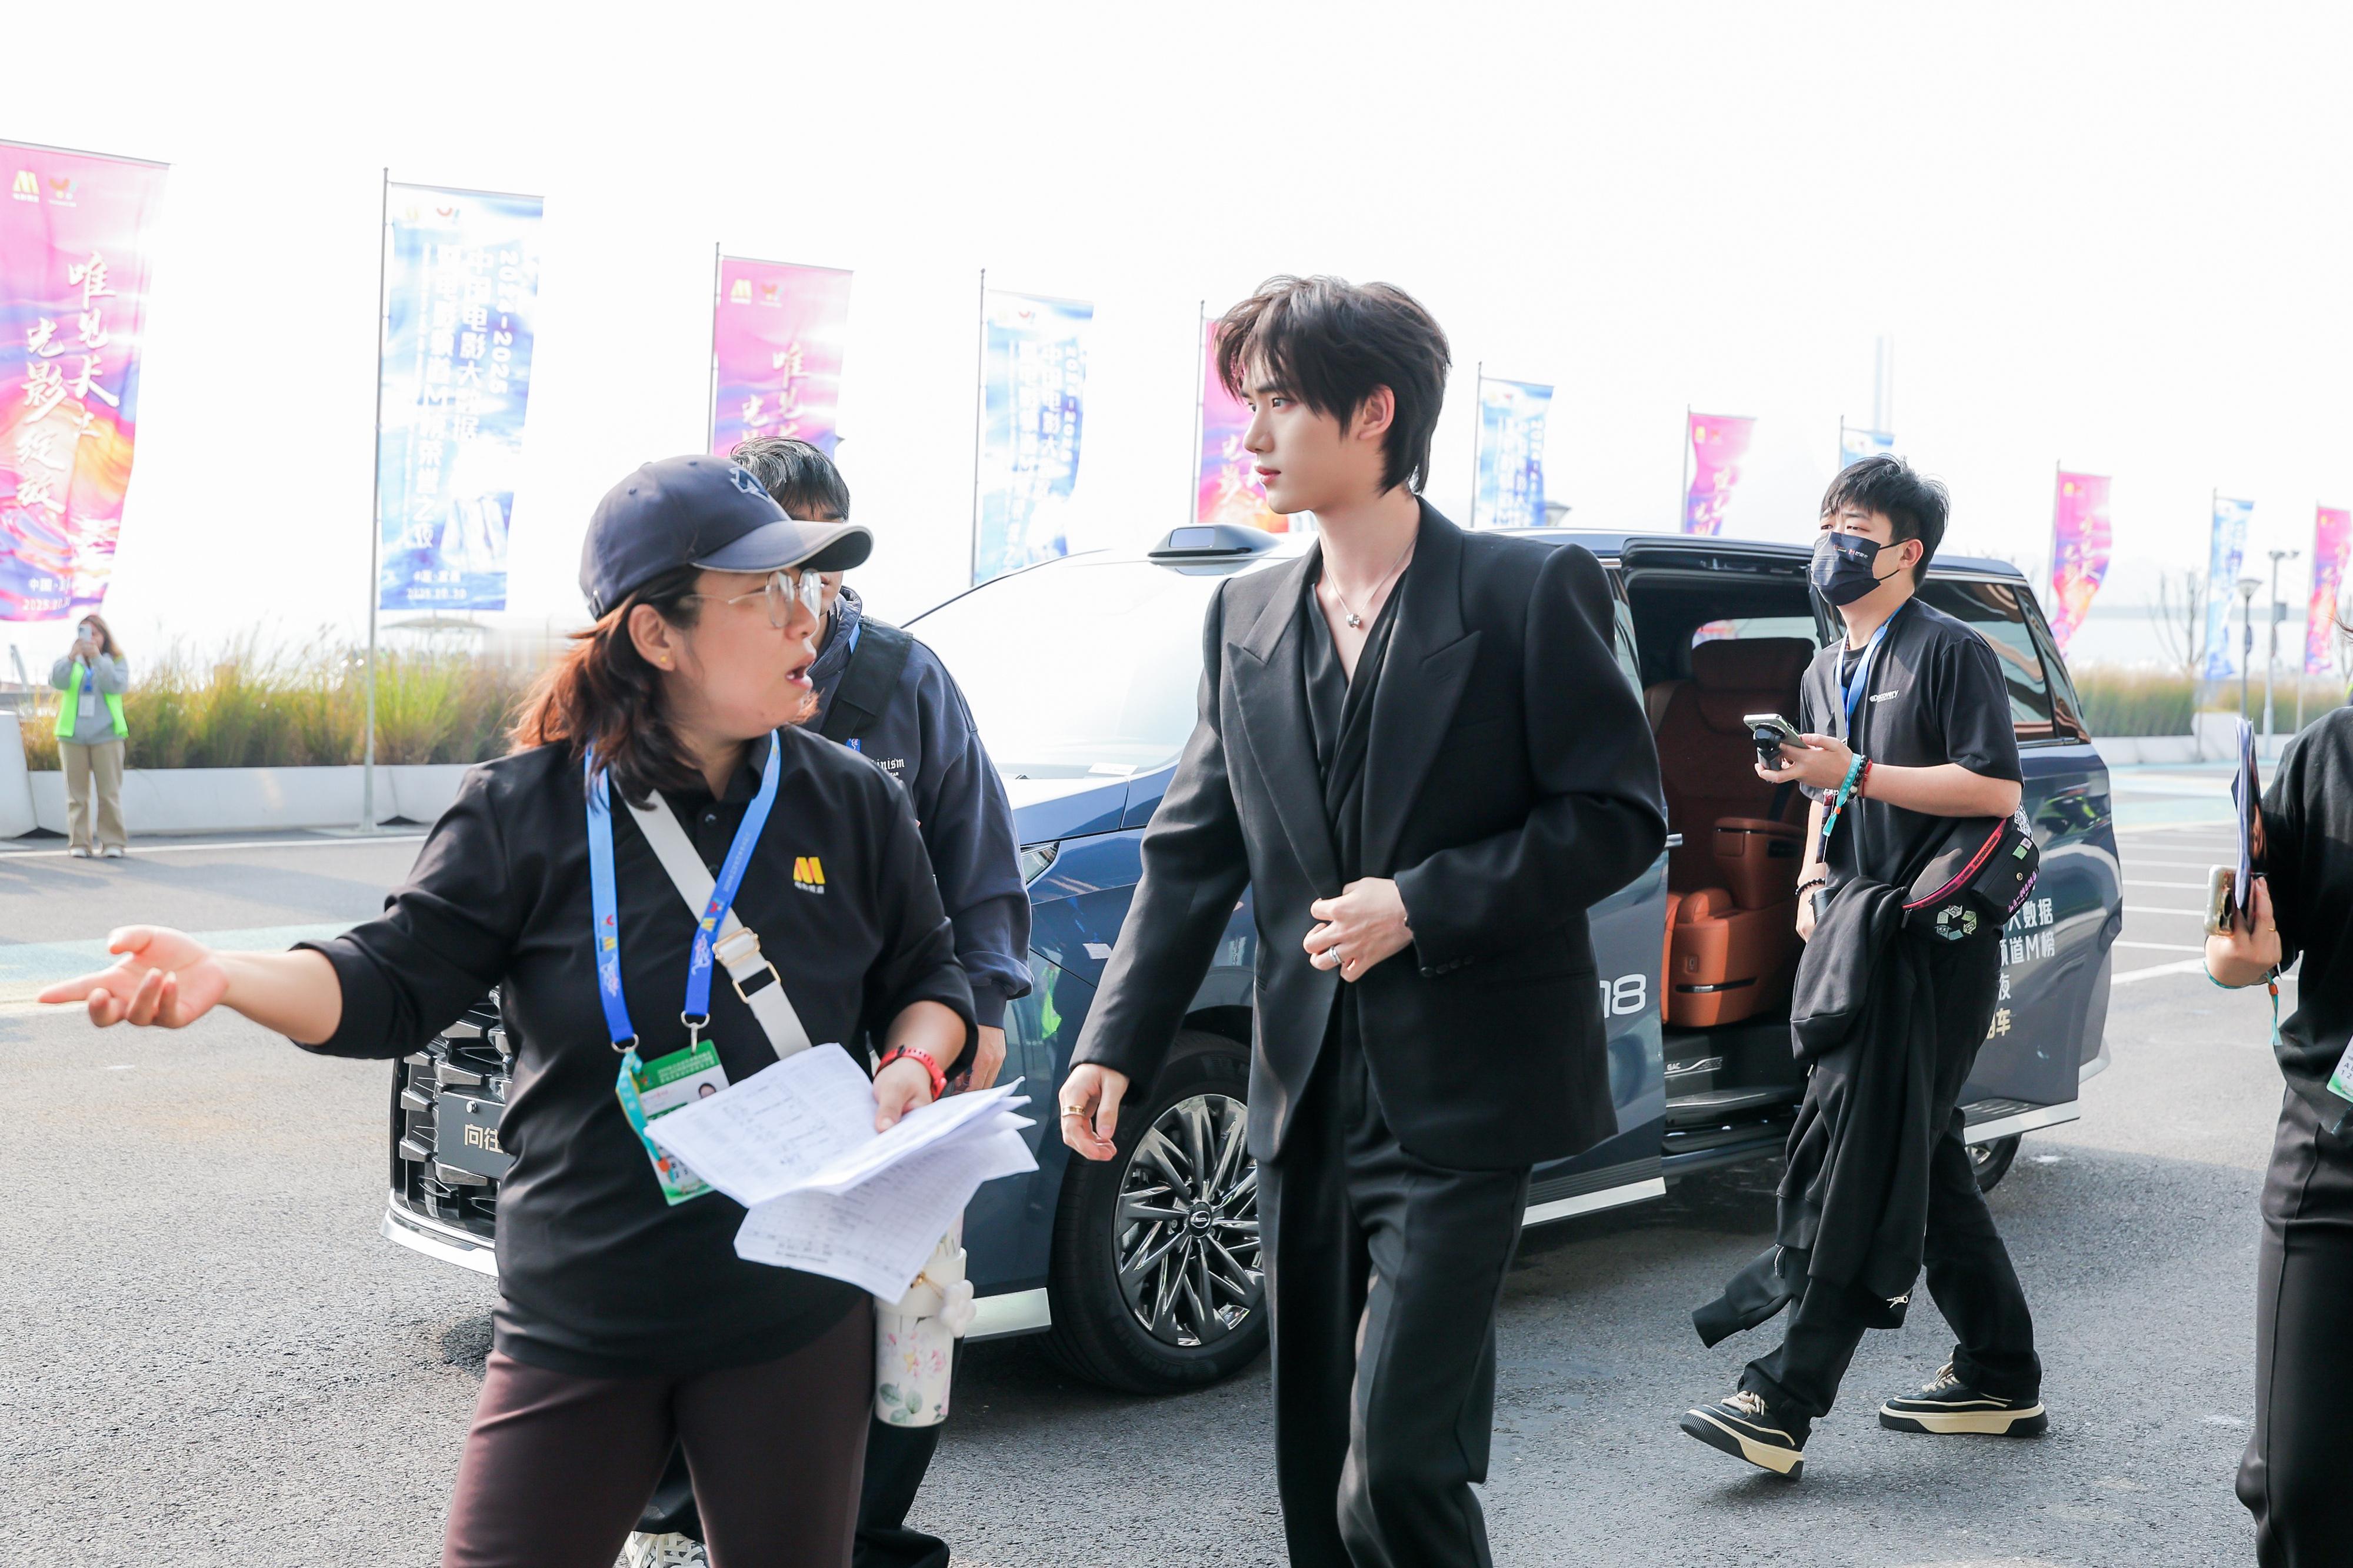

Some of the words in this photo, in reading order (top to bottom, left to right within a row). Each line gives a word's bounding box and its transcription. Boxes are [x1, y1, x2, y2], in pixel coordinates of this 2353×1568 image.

[773, 341, 809, 437] 唯见
[1667, 1062, 1681, 1070] GAC
[465, 1123, 510, 1156] 向往
